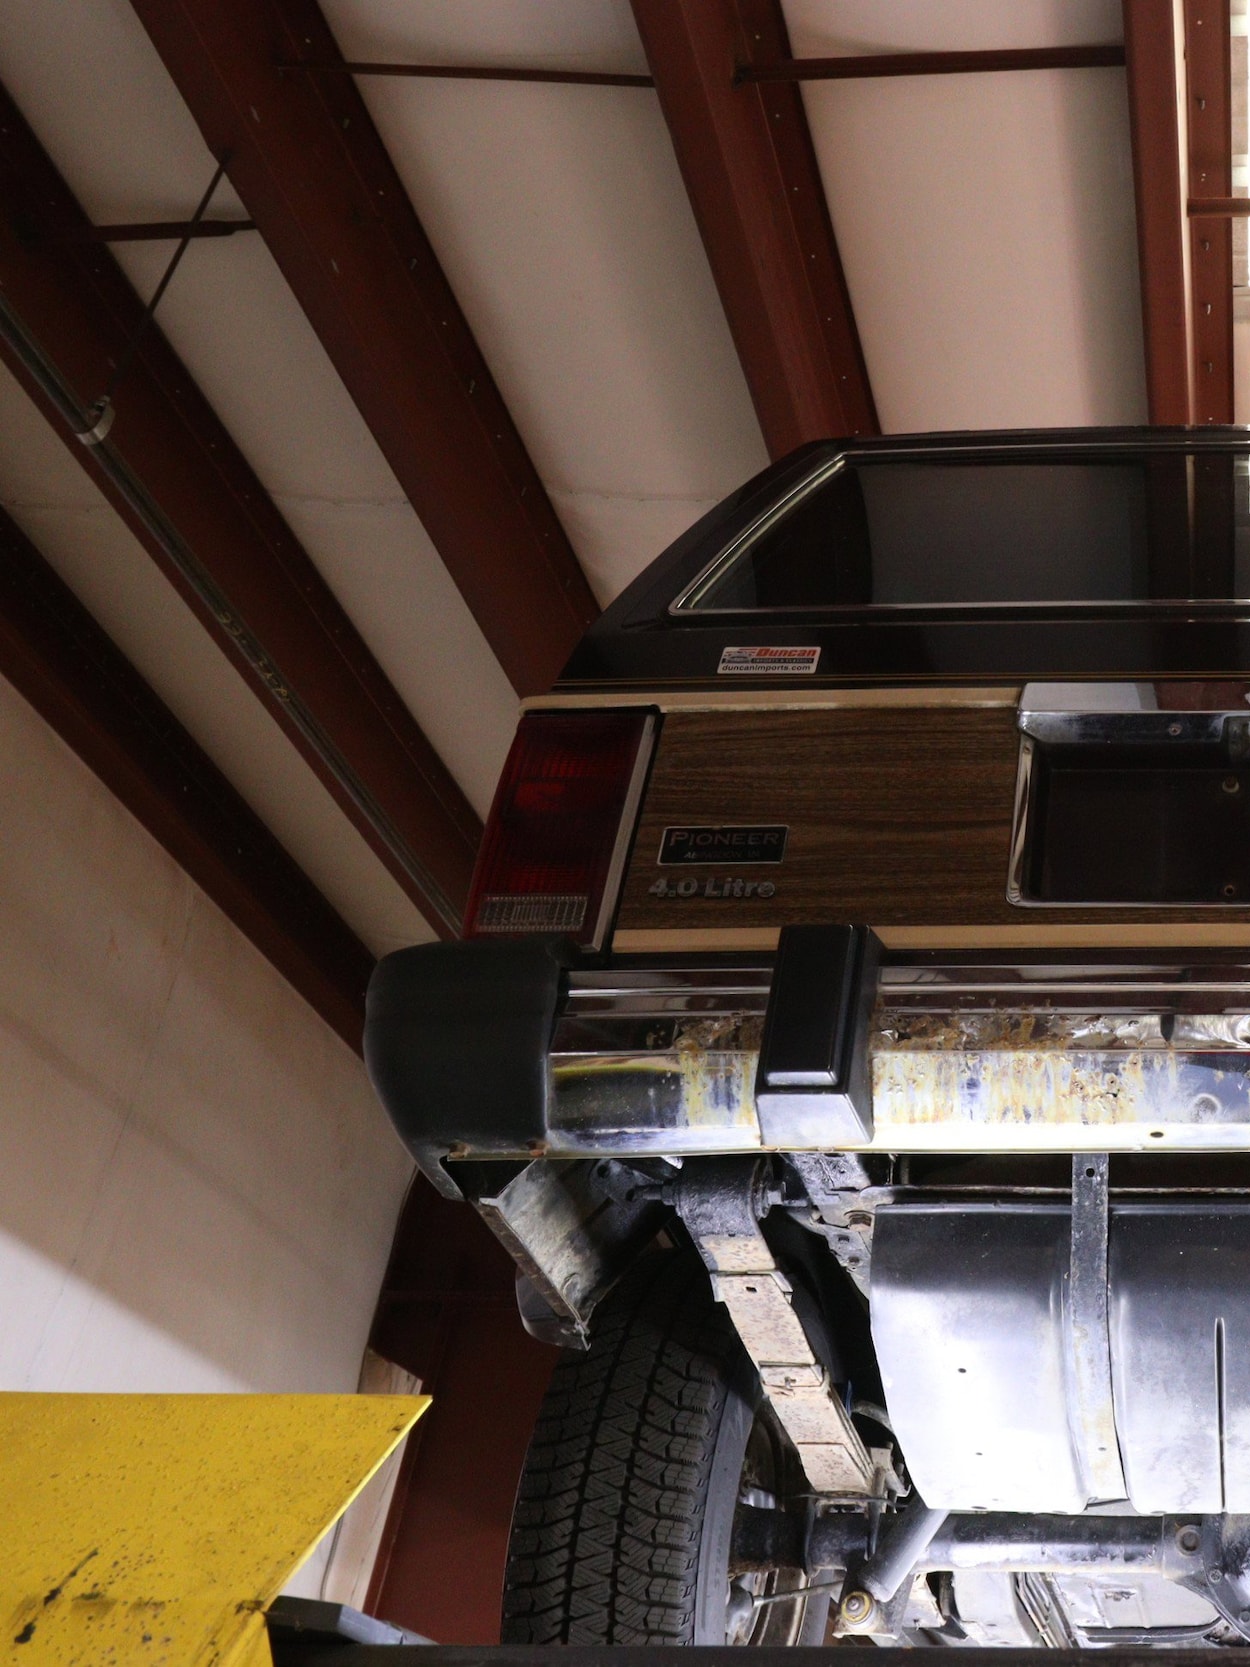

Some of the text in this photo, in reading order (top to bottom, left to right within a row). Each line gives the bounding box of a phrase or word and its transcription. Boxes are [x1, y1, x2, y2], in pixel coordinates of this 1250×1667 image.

[755, 648, 818, 657] Duncan
[721, 664, 811, 672] duncanimports.com
[669, 831, 780, 846] PIONEER
[648, 877, 776, 898] 4.0 Litre
